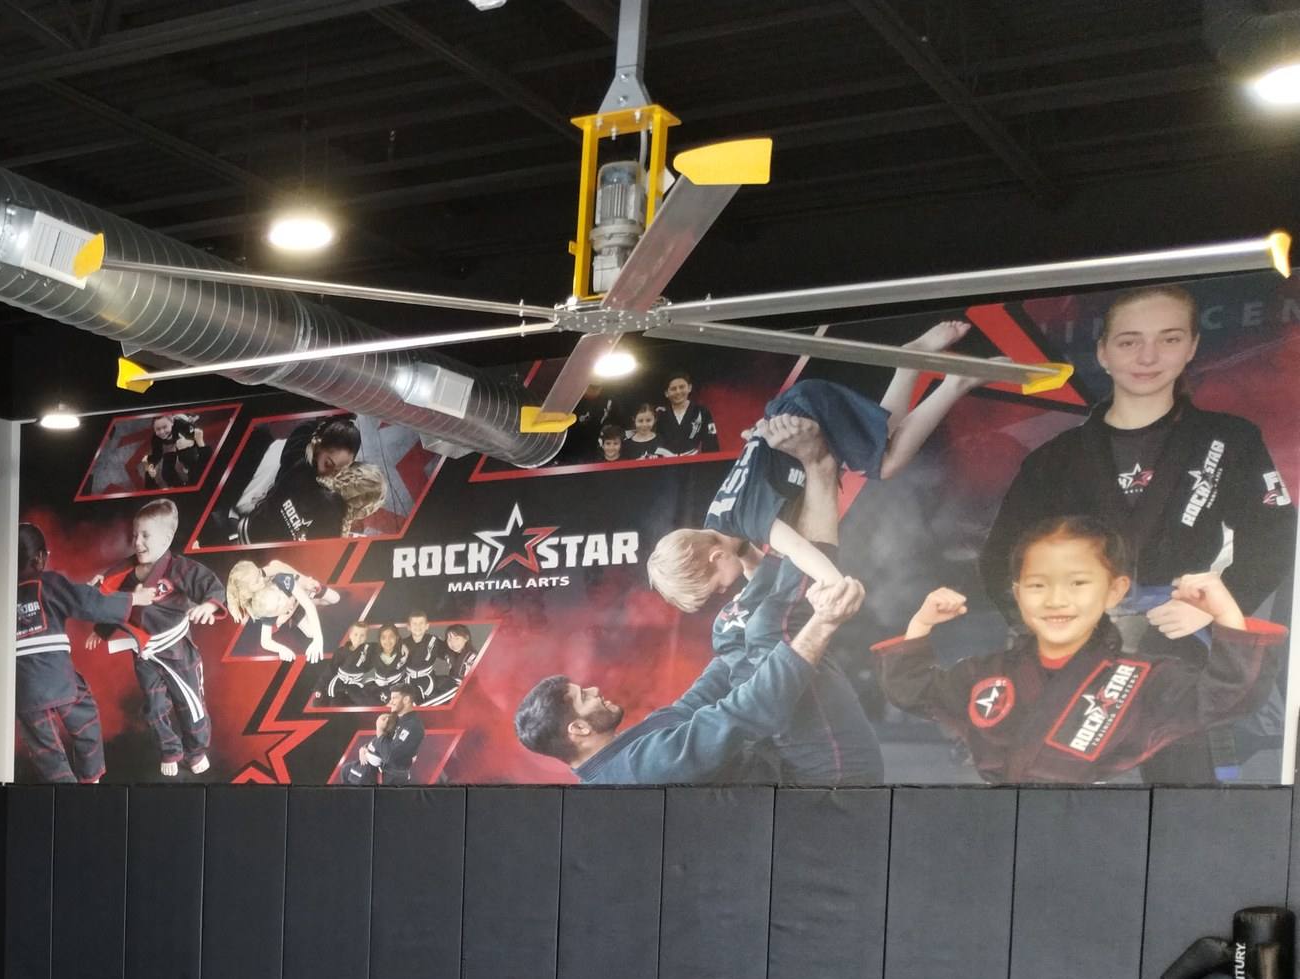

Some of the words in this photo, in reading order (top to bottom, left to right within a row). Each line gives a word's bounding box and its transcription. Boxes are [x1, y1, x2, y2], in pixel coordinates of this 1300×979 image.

[392, 542, 491, 579] ROCK
[536, 531, 639, 570] STAR
[447, 578, 522, 593] MARTIAL
[525, 576, 570, 588] ARTS
[1069, 709, 1107, 752] ROCK
[1103, 664, 1136, 700] STAR
